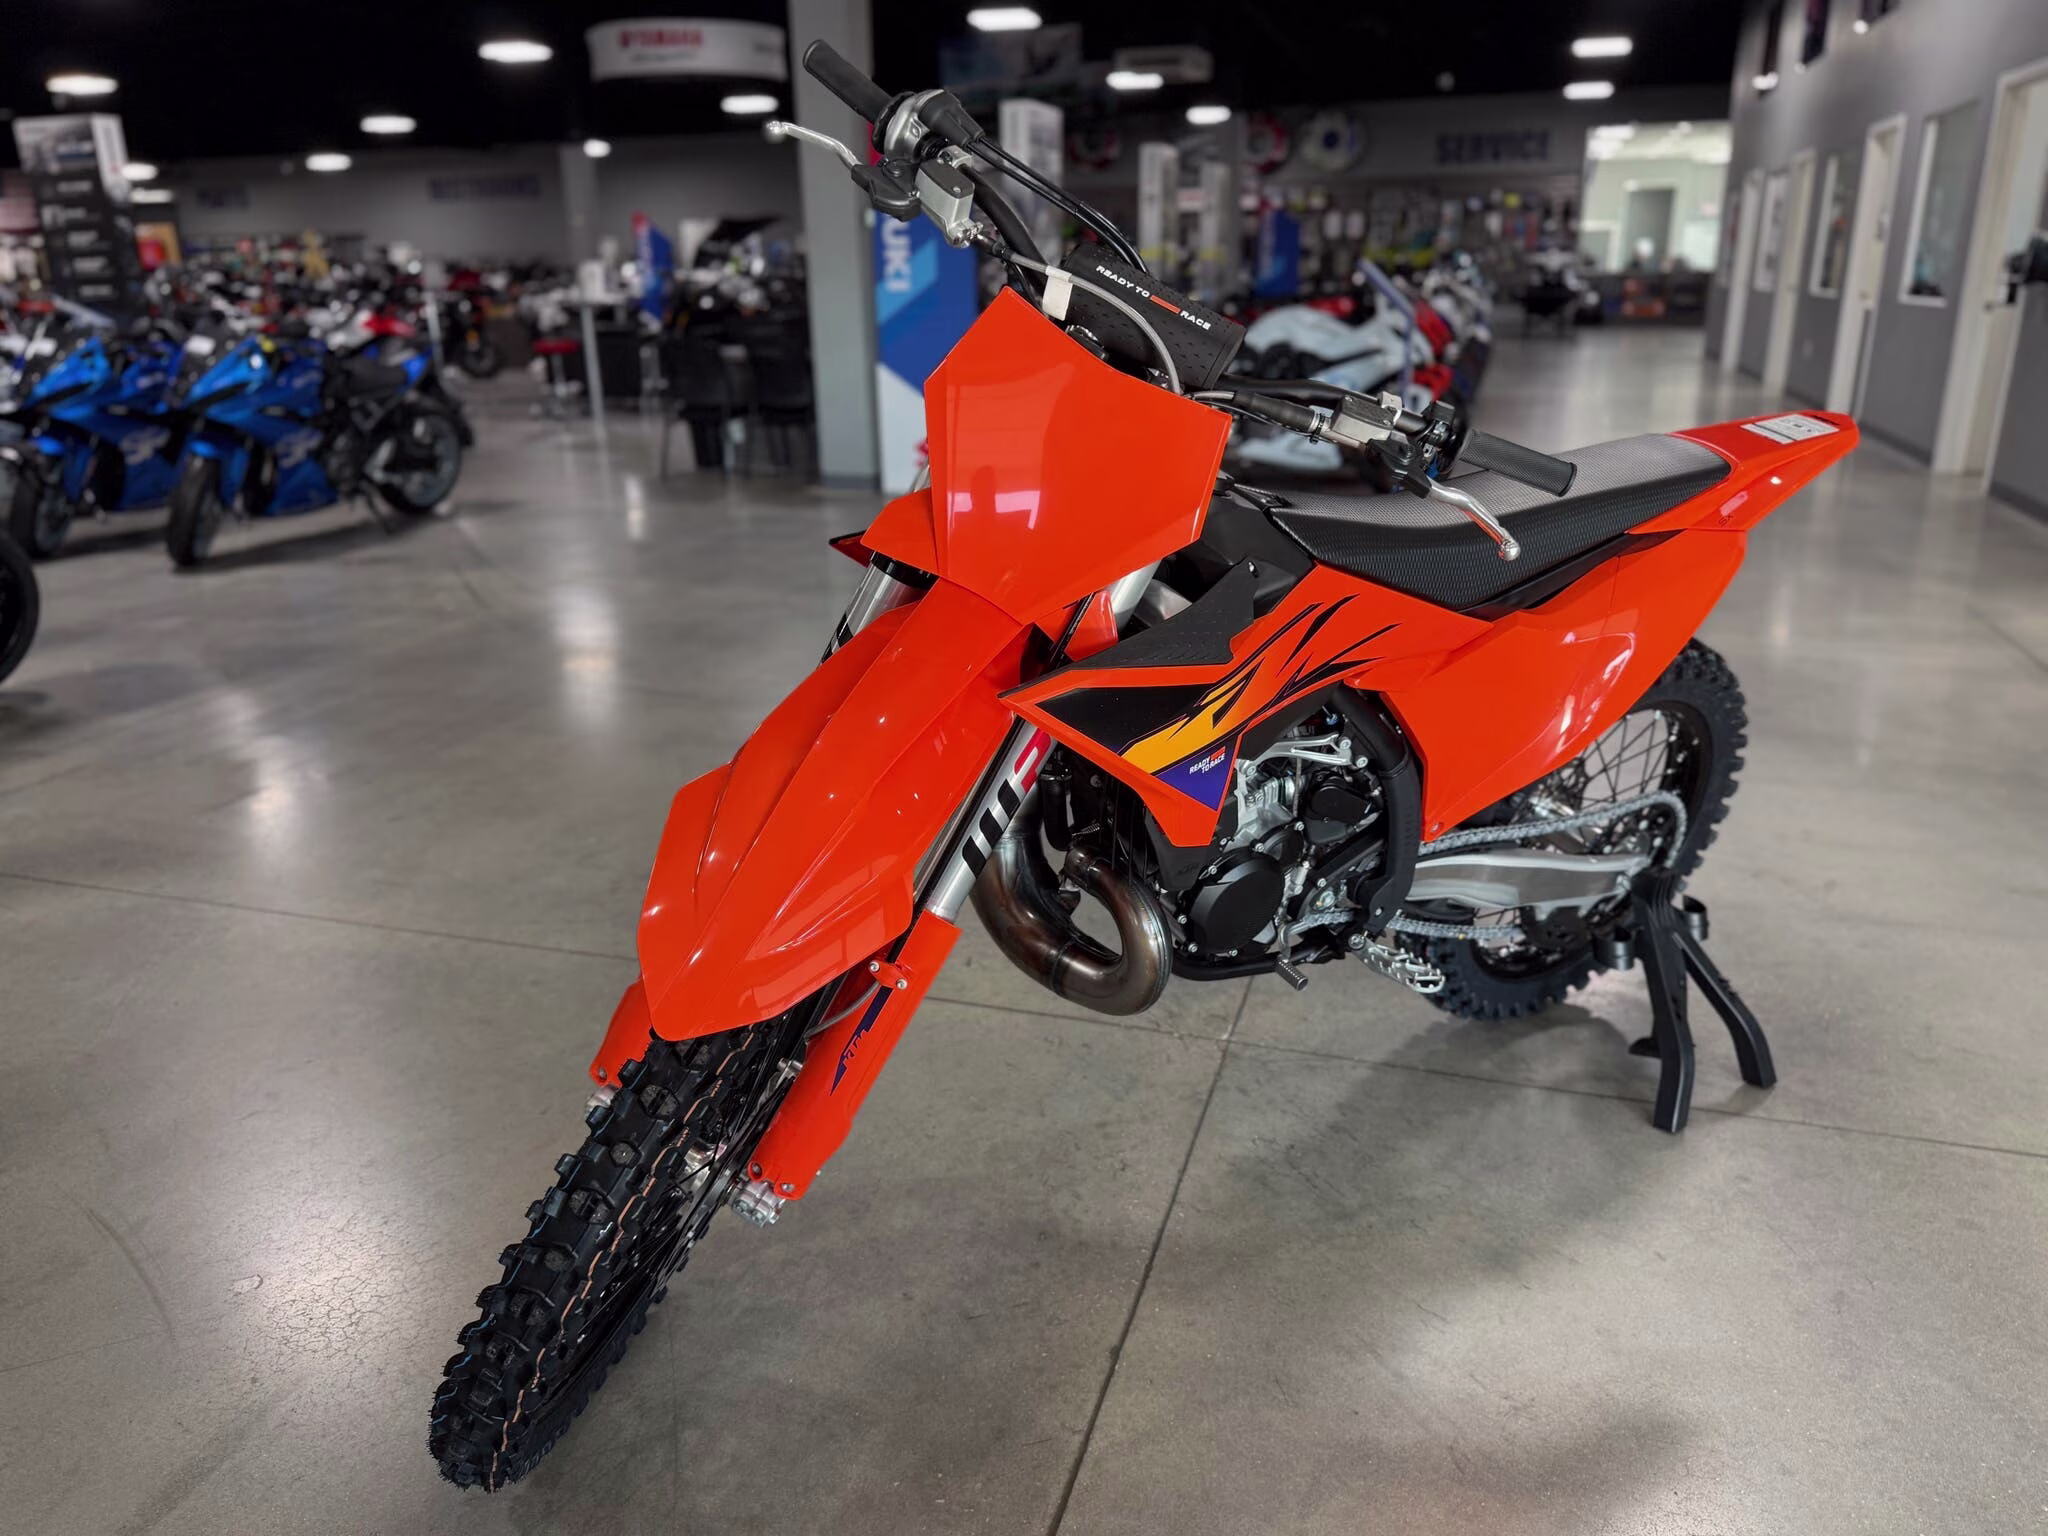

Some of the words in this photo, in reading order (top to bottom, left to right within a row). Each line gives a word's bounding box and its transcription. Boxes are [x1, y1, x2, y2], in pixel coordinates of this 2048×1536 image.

[882, 212, 912, 292] UKI
[1096, 265, 1135, 288] READY
[1136, 286, 1150, 298] TO
[1180, 310, 1212, 330] RACE
[1189, 756, 1210, 774] READY
[1202, 764, 1209, 774] TO
[1210, 753, 1225, 768] RACE
